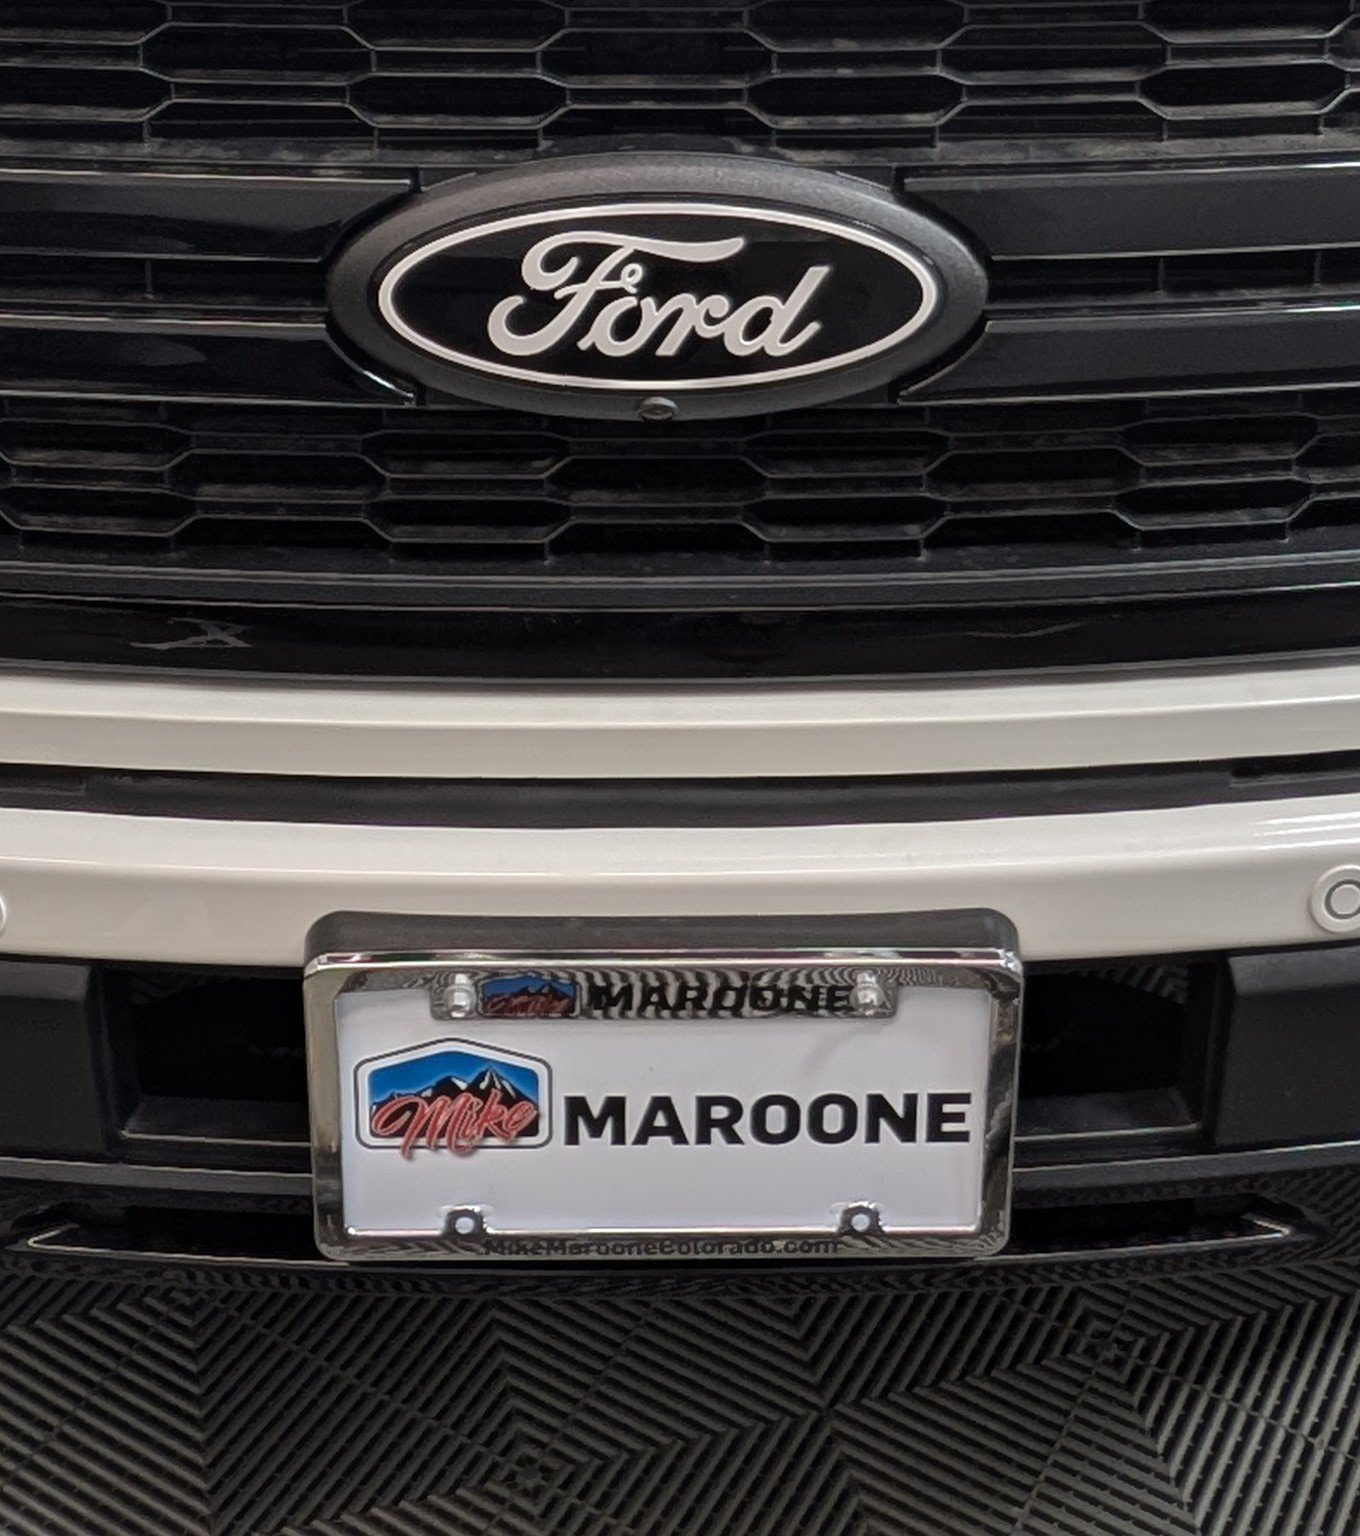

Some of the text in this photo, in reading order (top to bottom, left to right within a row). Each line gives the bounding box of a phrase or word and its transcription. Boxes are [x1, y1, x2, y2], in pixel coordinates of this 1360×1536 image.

[488, 230, 832, 357] Ford
[590, 983, 856, 1012] MAROONE
[371, 1088, 973, 1161] Mike MAROONE
